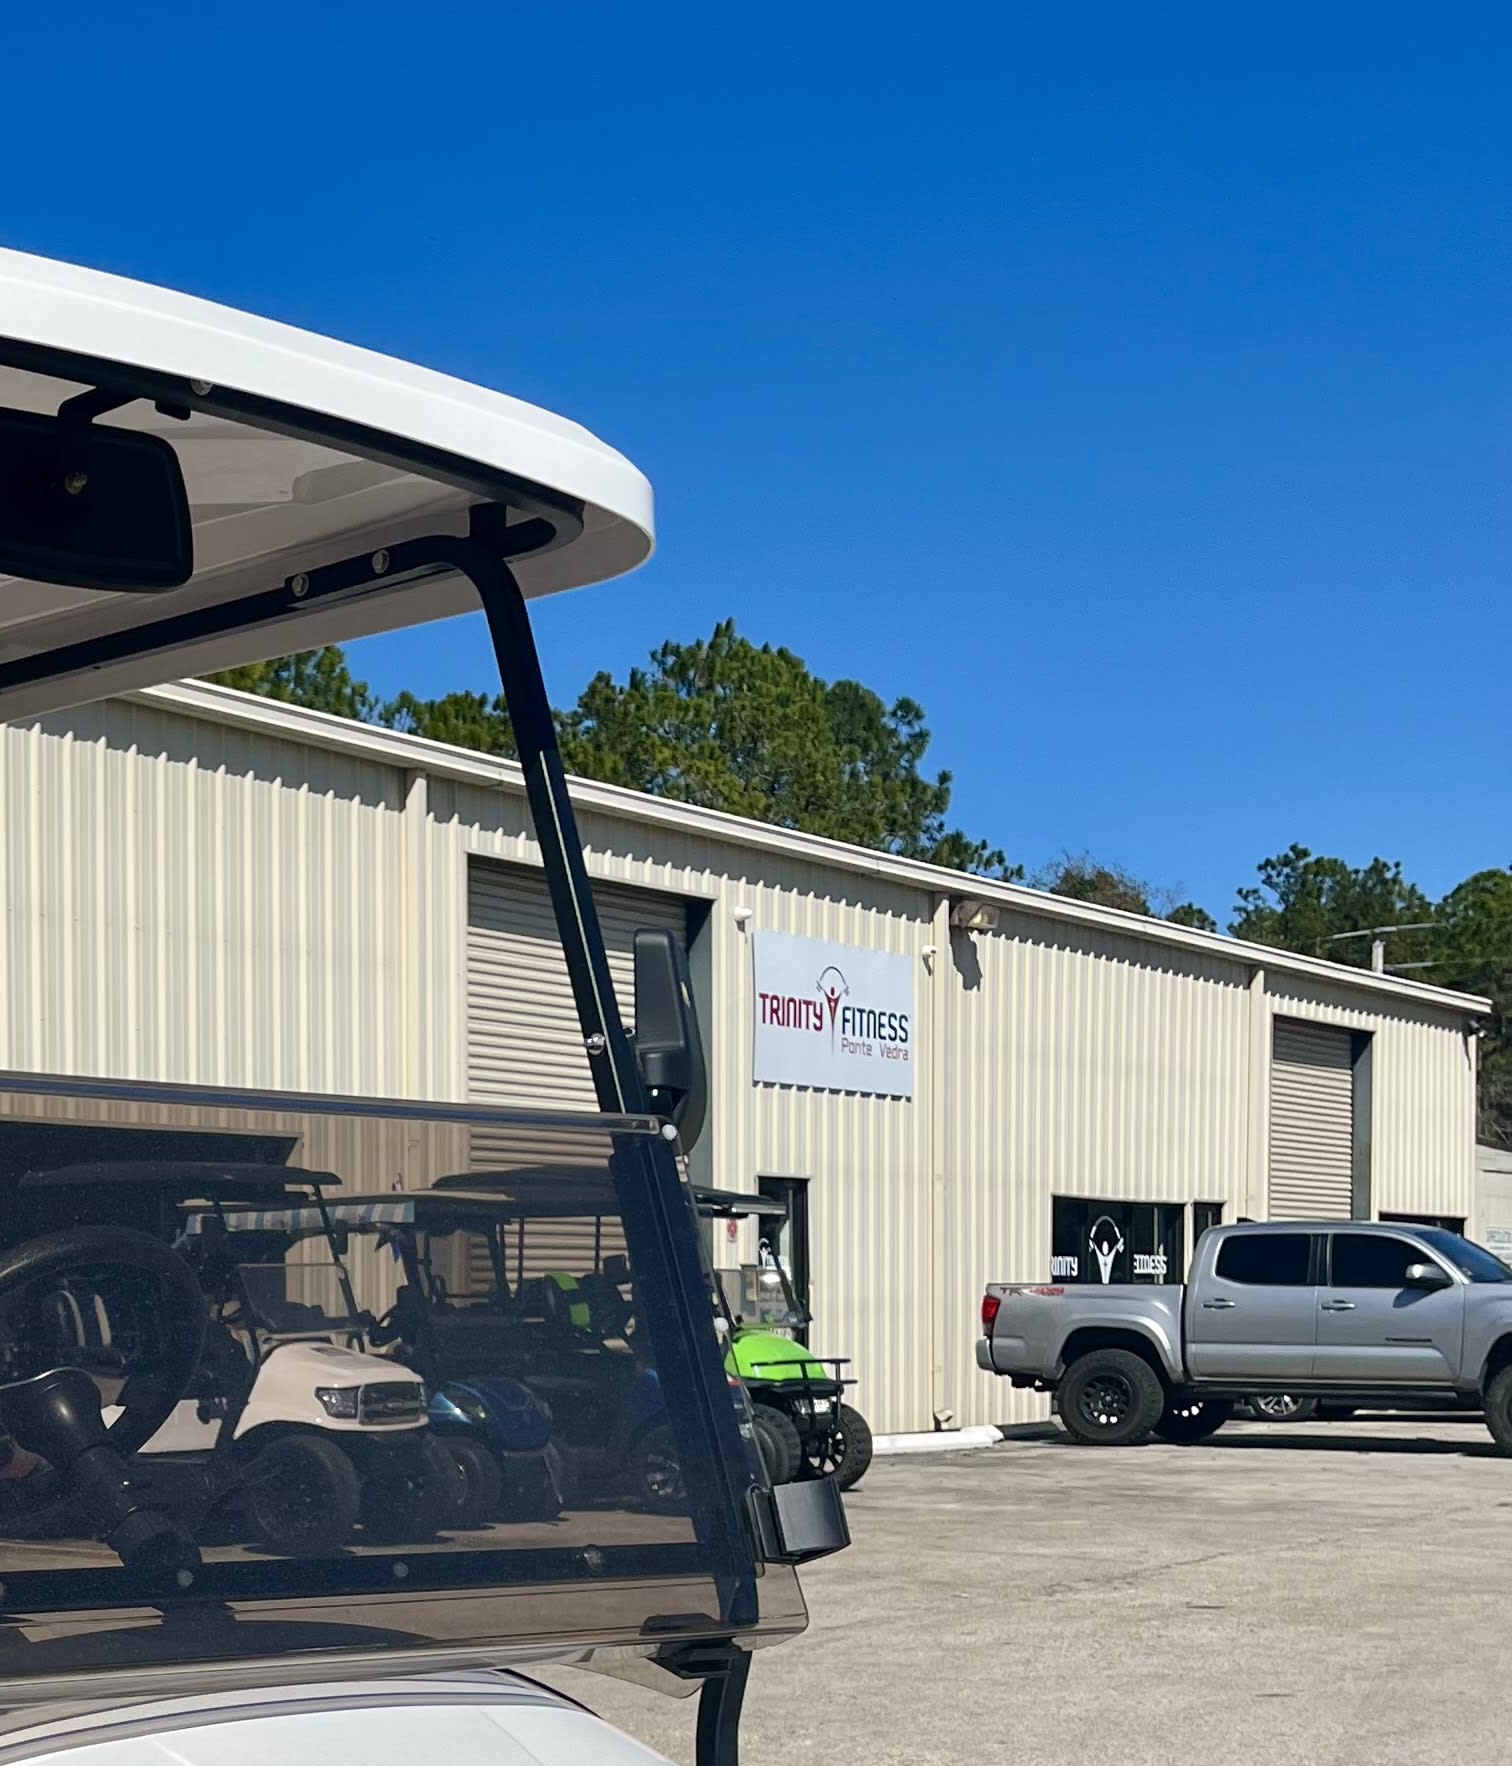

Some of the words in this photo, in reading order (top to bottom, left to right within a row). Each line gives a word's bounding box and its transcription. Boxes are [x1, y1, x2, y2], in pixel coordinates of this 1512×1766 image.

[759, 993, 823, 1031] TRINITY
[842, 1006, 909, 1043] FITNESS
[841, 1038, 873, 1057] Ponte
[880, 1045, 909, 1061] Vedra
